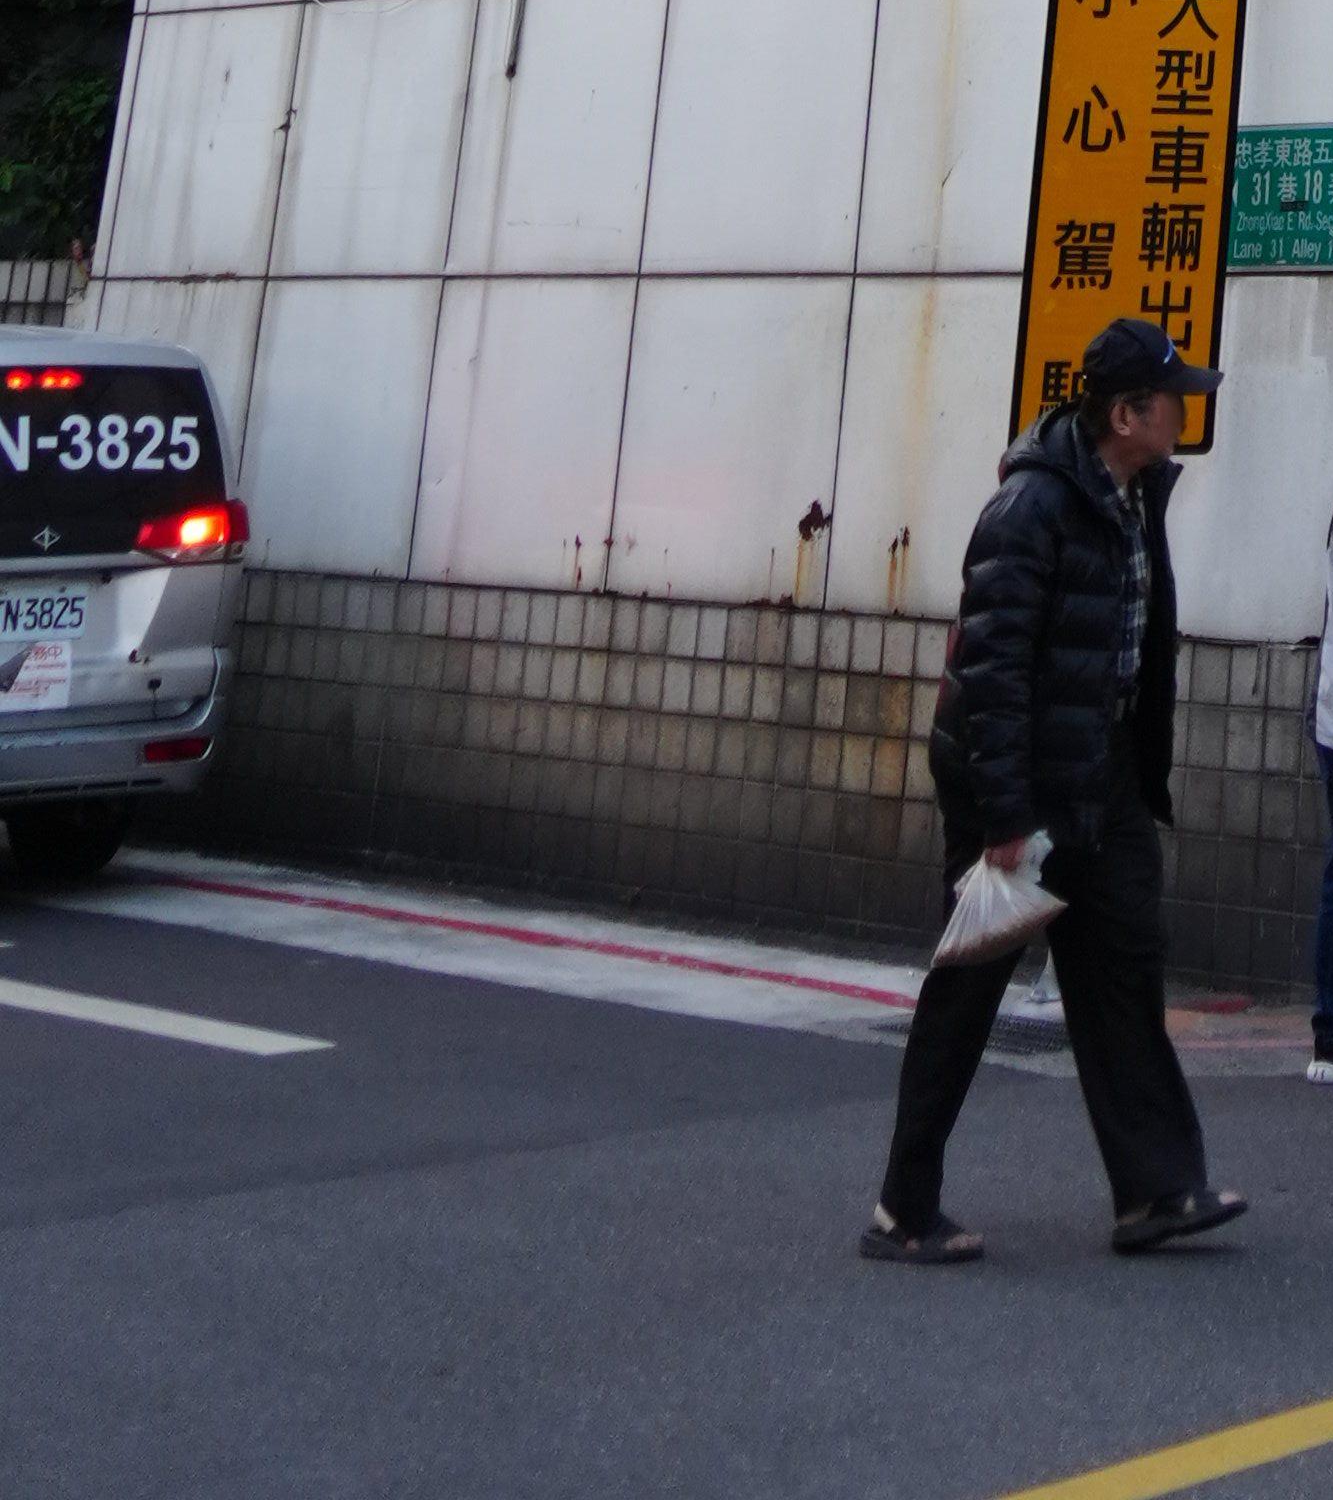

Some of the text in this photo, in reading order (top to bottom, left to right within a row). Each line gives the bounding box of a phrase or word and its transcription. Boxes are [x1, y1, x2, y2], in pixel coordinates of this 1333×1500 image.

[1233, 239, 1262, 259] Lane
[1270, 237, 1284, 258] 31
[1292, 238, 1322, 263] Alley
